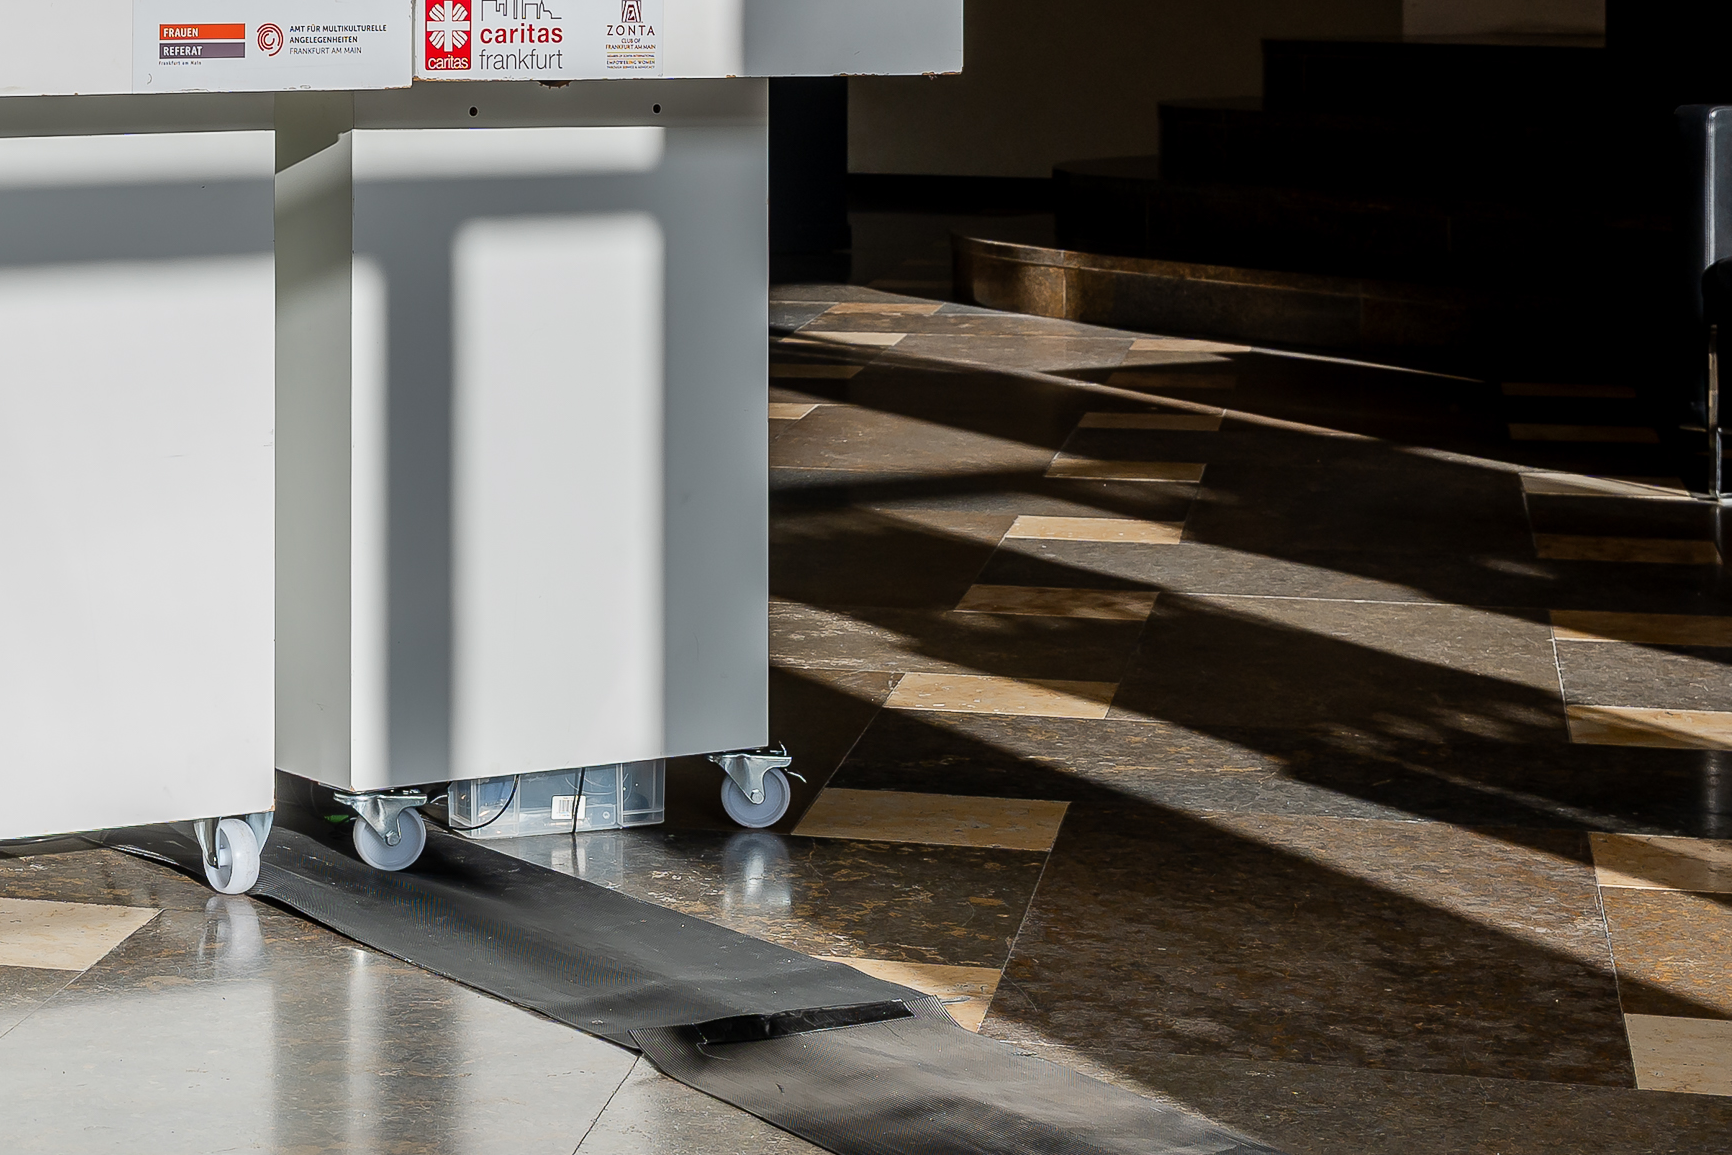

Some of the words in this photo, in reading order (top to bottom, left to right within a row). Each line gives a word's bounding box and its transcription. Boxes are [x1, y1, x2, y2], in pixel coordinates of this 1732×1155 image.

[163, 27, 199, 37] FRAUEN
[307, 24, 320, 32] FÜR
[322, 24, 387, 32] MULTIKULTURELLE
[606, 25, 655, 36] ZONTA
[479, 23, 563, 44] caritas
[163, 46, 202, 56] REFERAT
[289, 47, 329, 55] FRANKFURT
[428, 54, 468, 69] caritas
[479, 49, 563, 70] frankfurt
